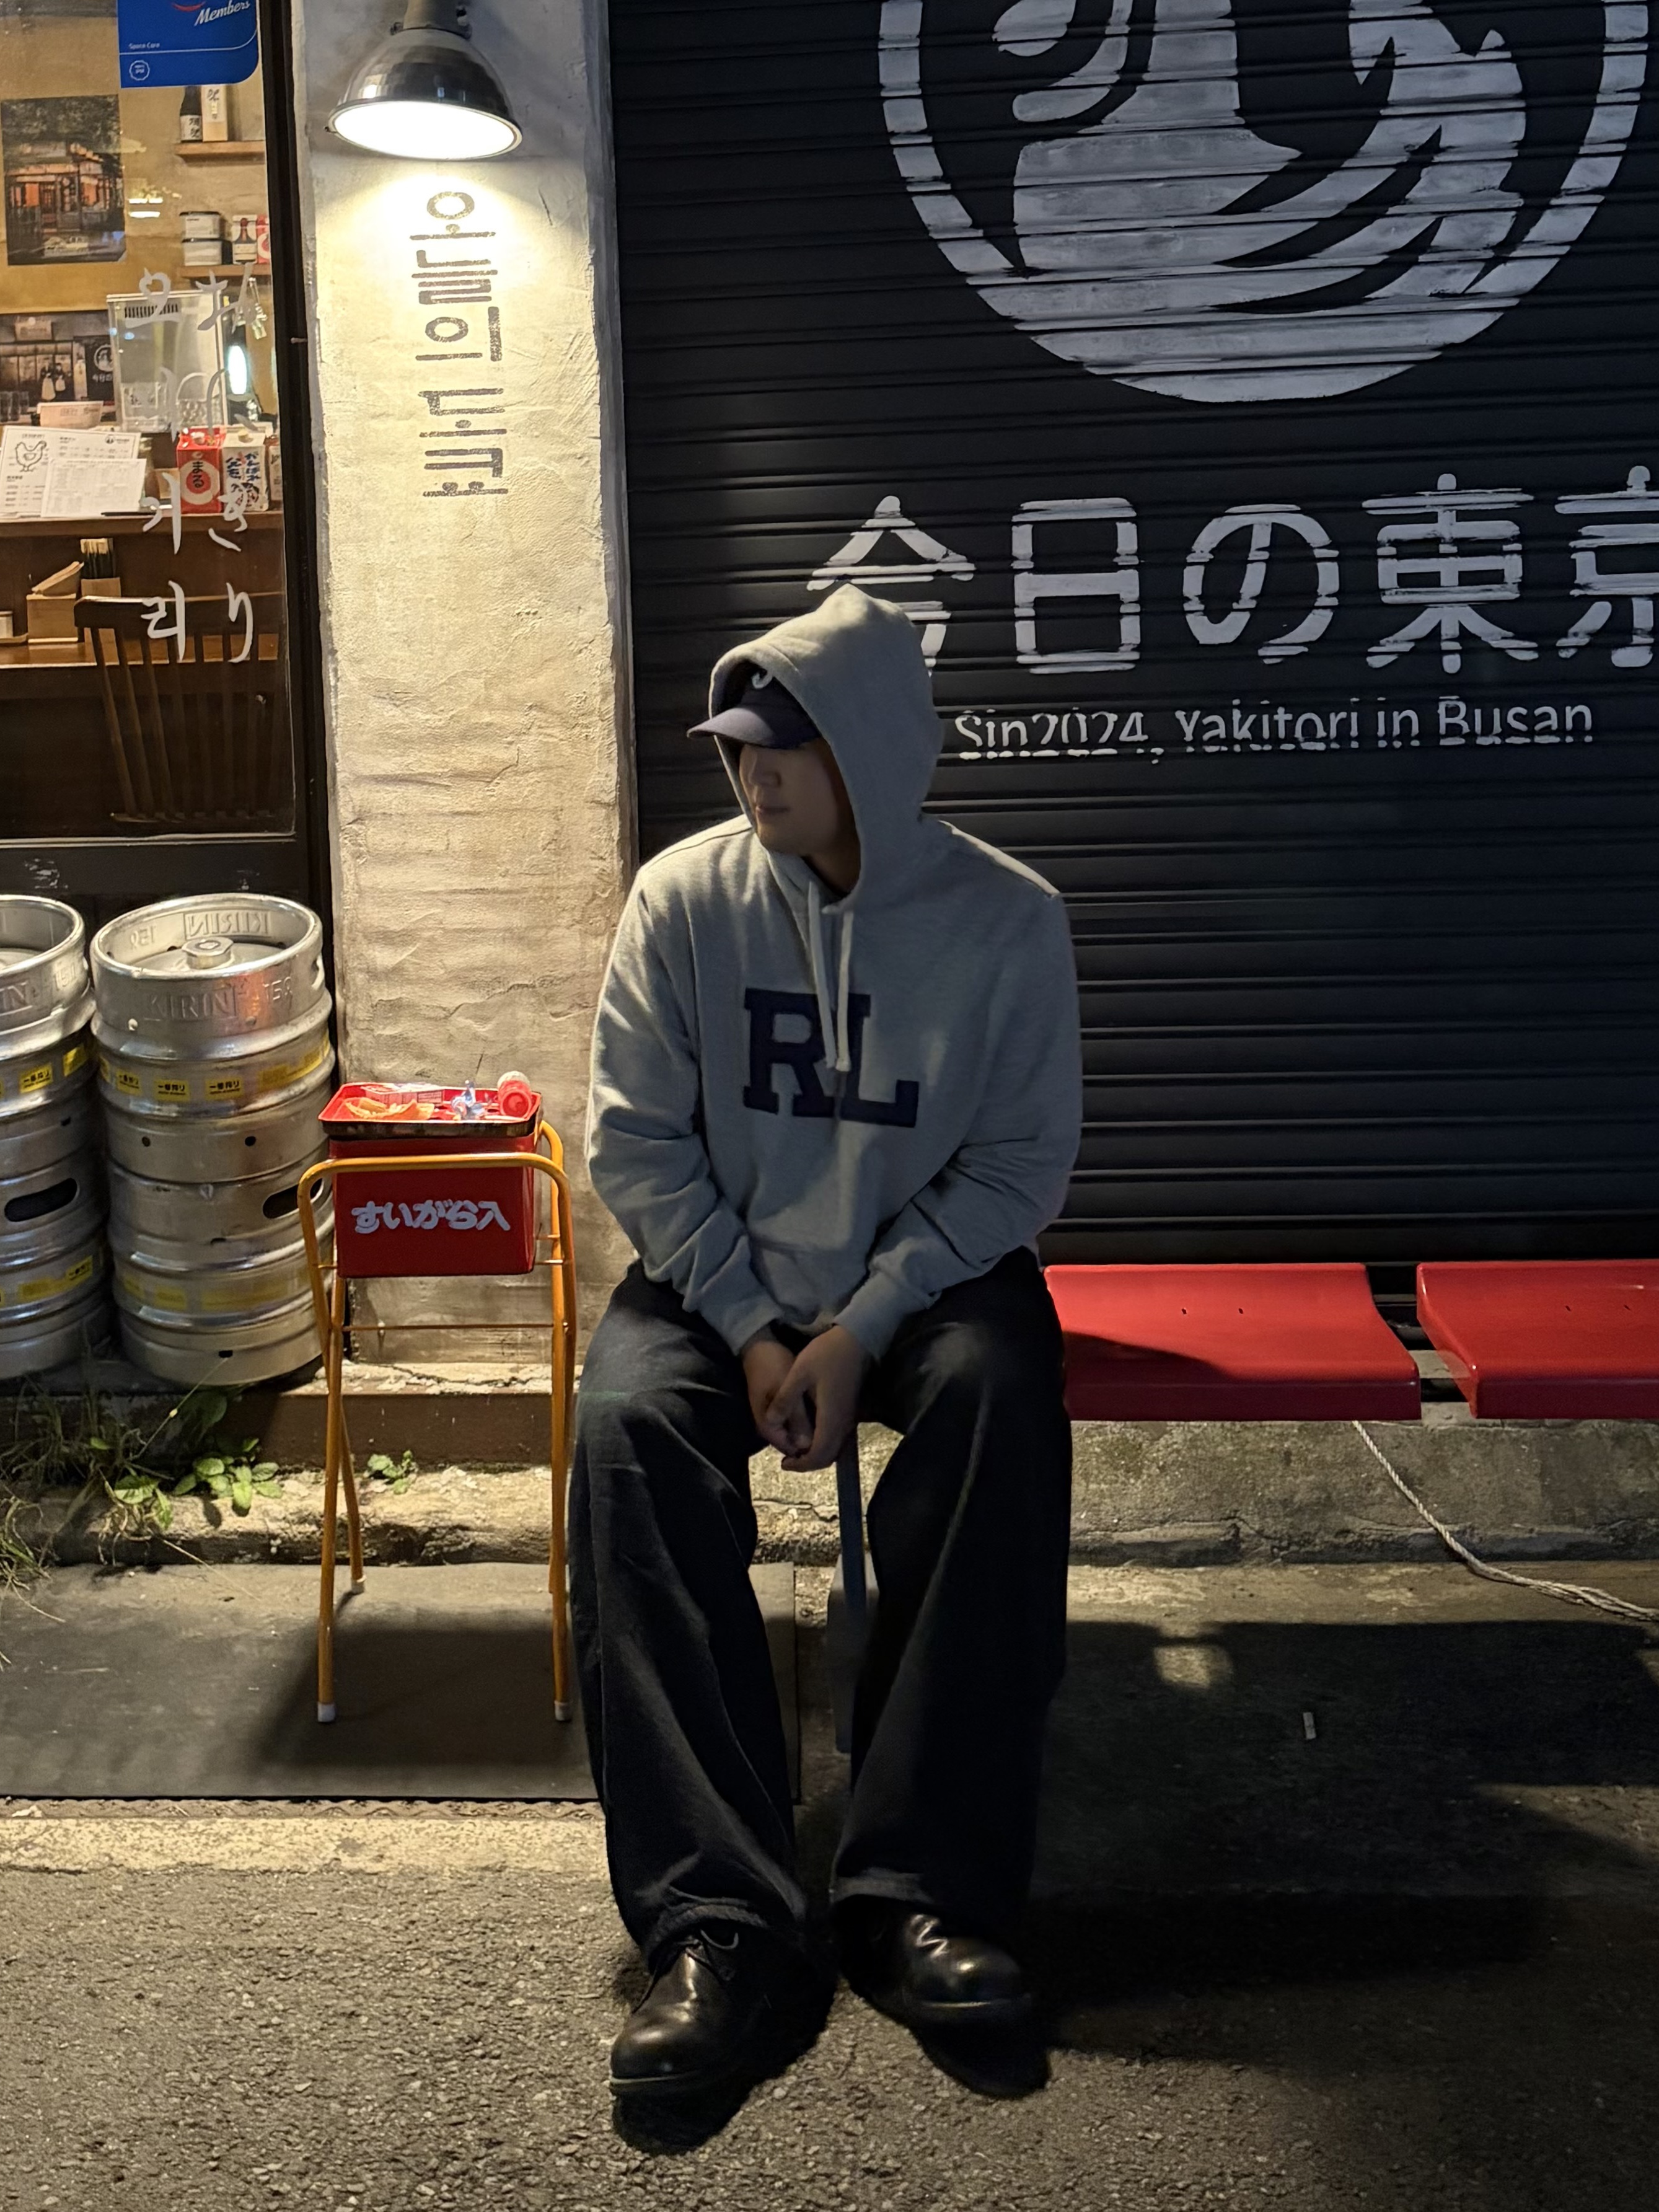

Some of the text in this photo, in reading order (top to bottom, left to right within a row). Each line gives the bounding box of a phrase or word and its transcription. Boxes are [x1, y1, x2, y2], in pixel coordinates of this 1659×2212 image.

[193, 0, 251, 27] Members
[409, 191, 509, 498] 오늘의 도쿄
[192, 461, 205, 488] まる
[1174, 698, 1359, 754] Yakitori
[1376, 697, 1420, 749] in
[1437, 695, 1593, 746] Busan
[151, 985, 236, 1020] KIRIN
[742, 987, 920, 1129] RL
[351, 1199, 511, 1234] すいがら入
